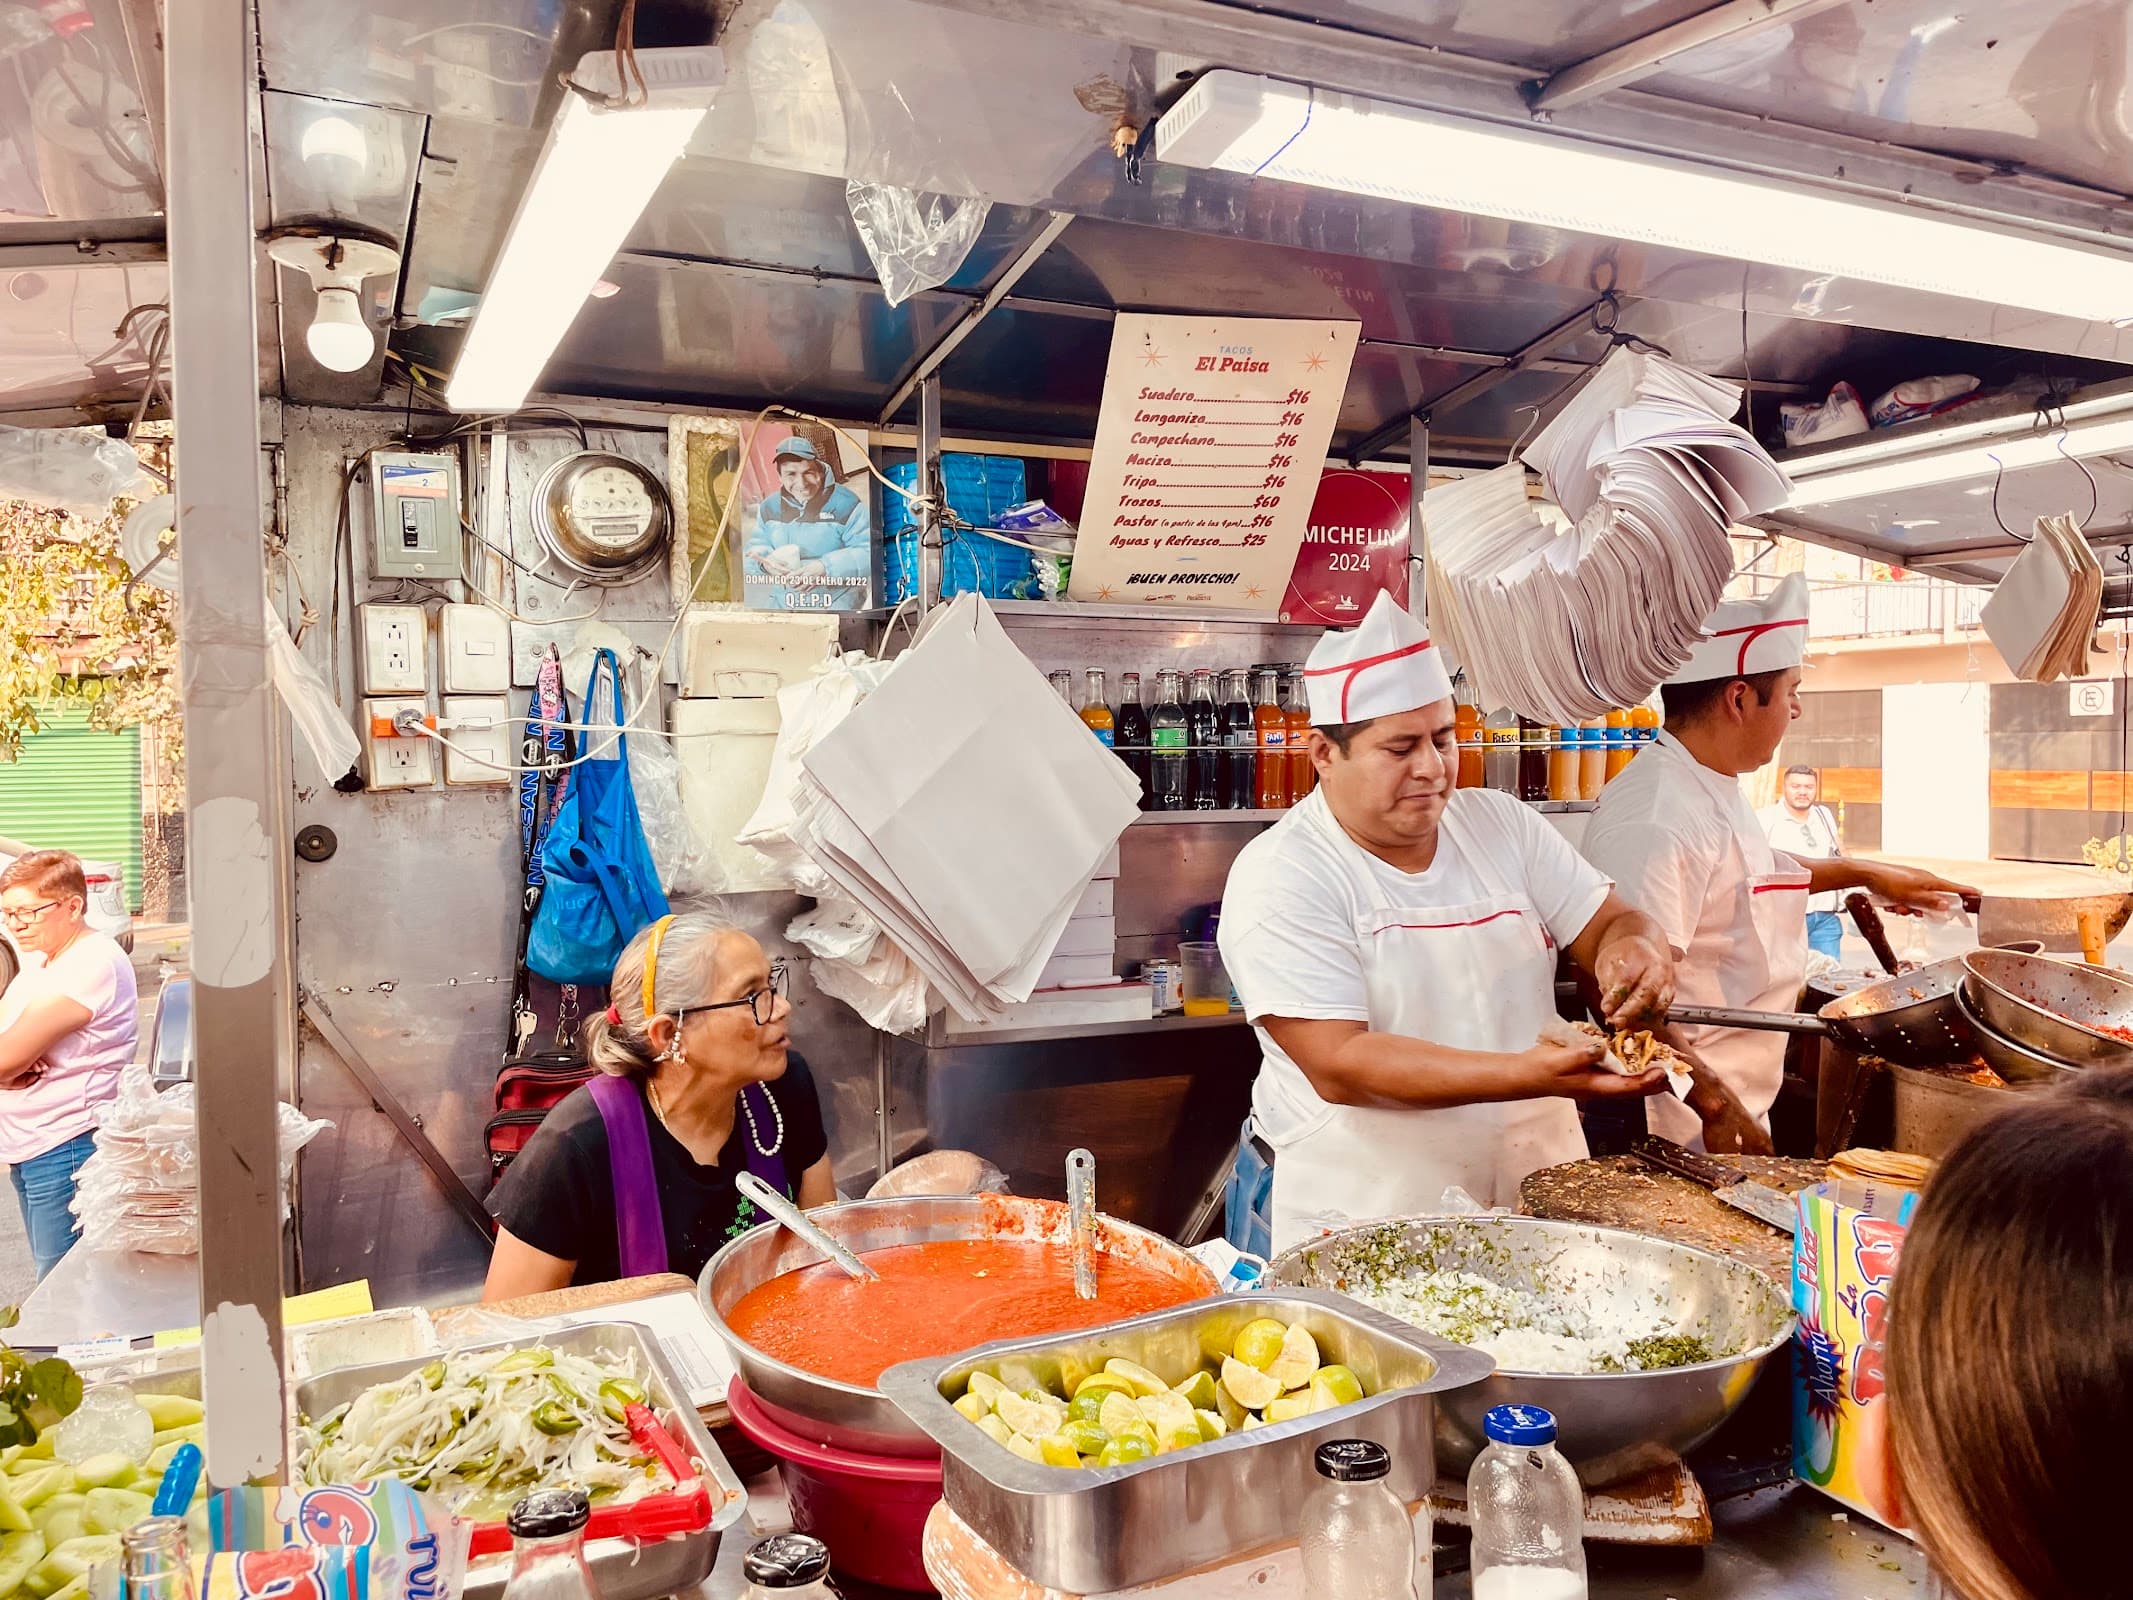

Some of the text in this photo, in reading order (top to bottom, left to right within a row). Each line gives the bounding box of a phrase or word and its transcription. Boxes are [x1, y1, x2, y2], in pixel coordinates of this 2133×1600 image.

[1219, 346, 1254, 355] TACOS
[1195, 356, 1269, 373] El Paisa
[1139, 388, 1309, 405] Suadero $16
[1135, 410, 1304, 426] Longaniza $16
[1131, 432, 1297, 448] Campechano $16
[1126, 455, 1291, 469] Maciza $16
[1123, 474, 1285, 490] Tripa $16
[1119, 494, 1280, 509] Trozos $60
[1114, 515, 1158, 527] Pastor
[1251, 514, 1274, 528] $16
[1110, 534, 1267, 549] Aguas y Refresco $25
[1302, 525, 1395, 547] MICHELIN
[1328, 552, 1371, 572] 2024
[745, 574, 867, 586] DOMINGO 23 DE ENERO 2022
[1127, 573, 1240, 585] ¡BUEN PROVECHO!
[785, 593, 832, 608] Q.E.P.D
[1797, 1228, 1819, 1291] Haz
[1838, 1283, 1858, 1319] La
[1809, 1331, 1840, 1408] Ahorra
